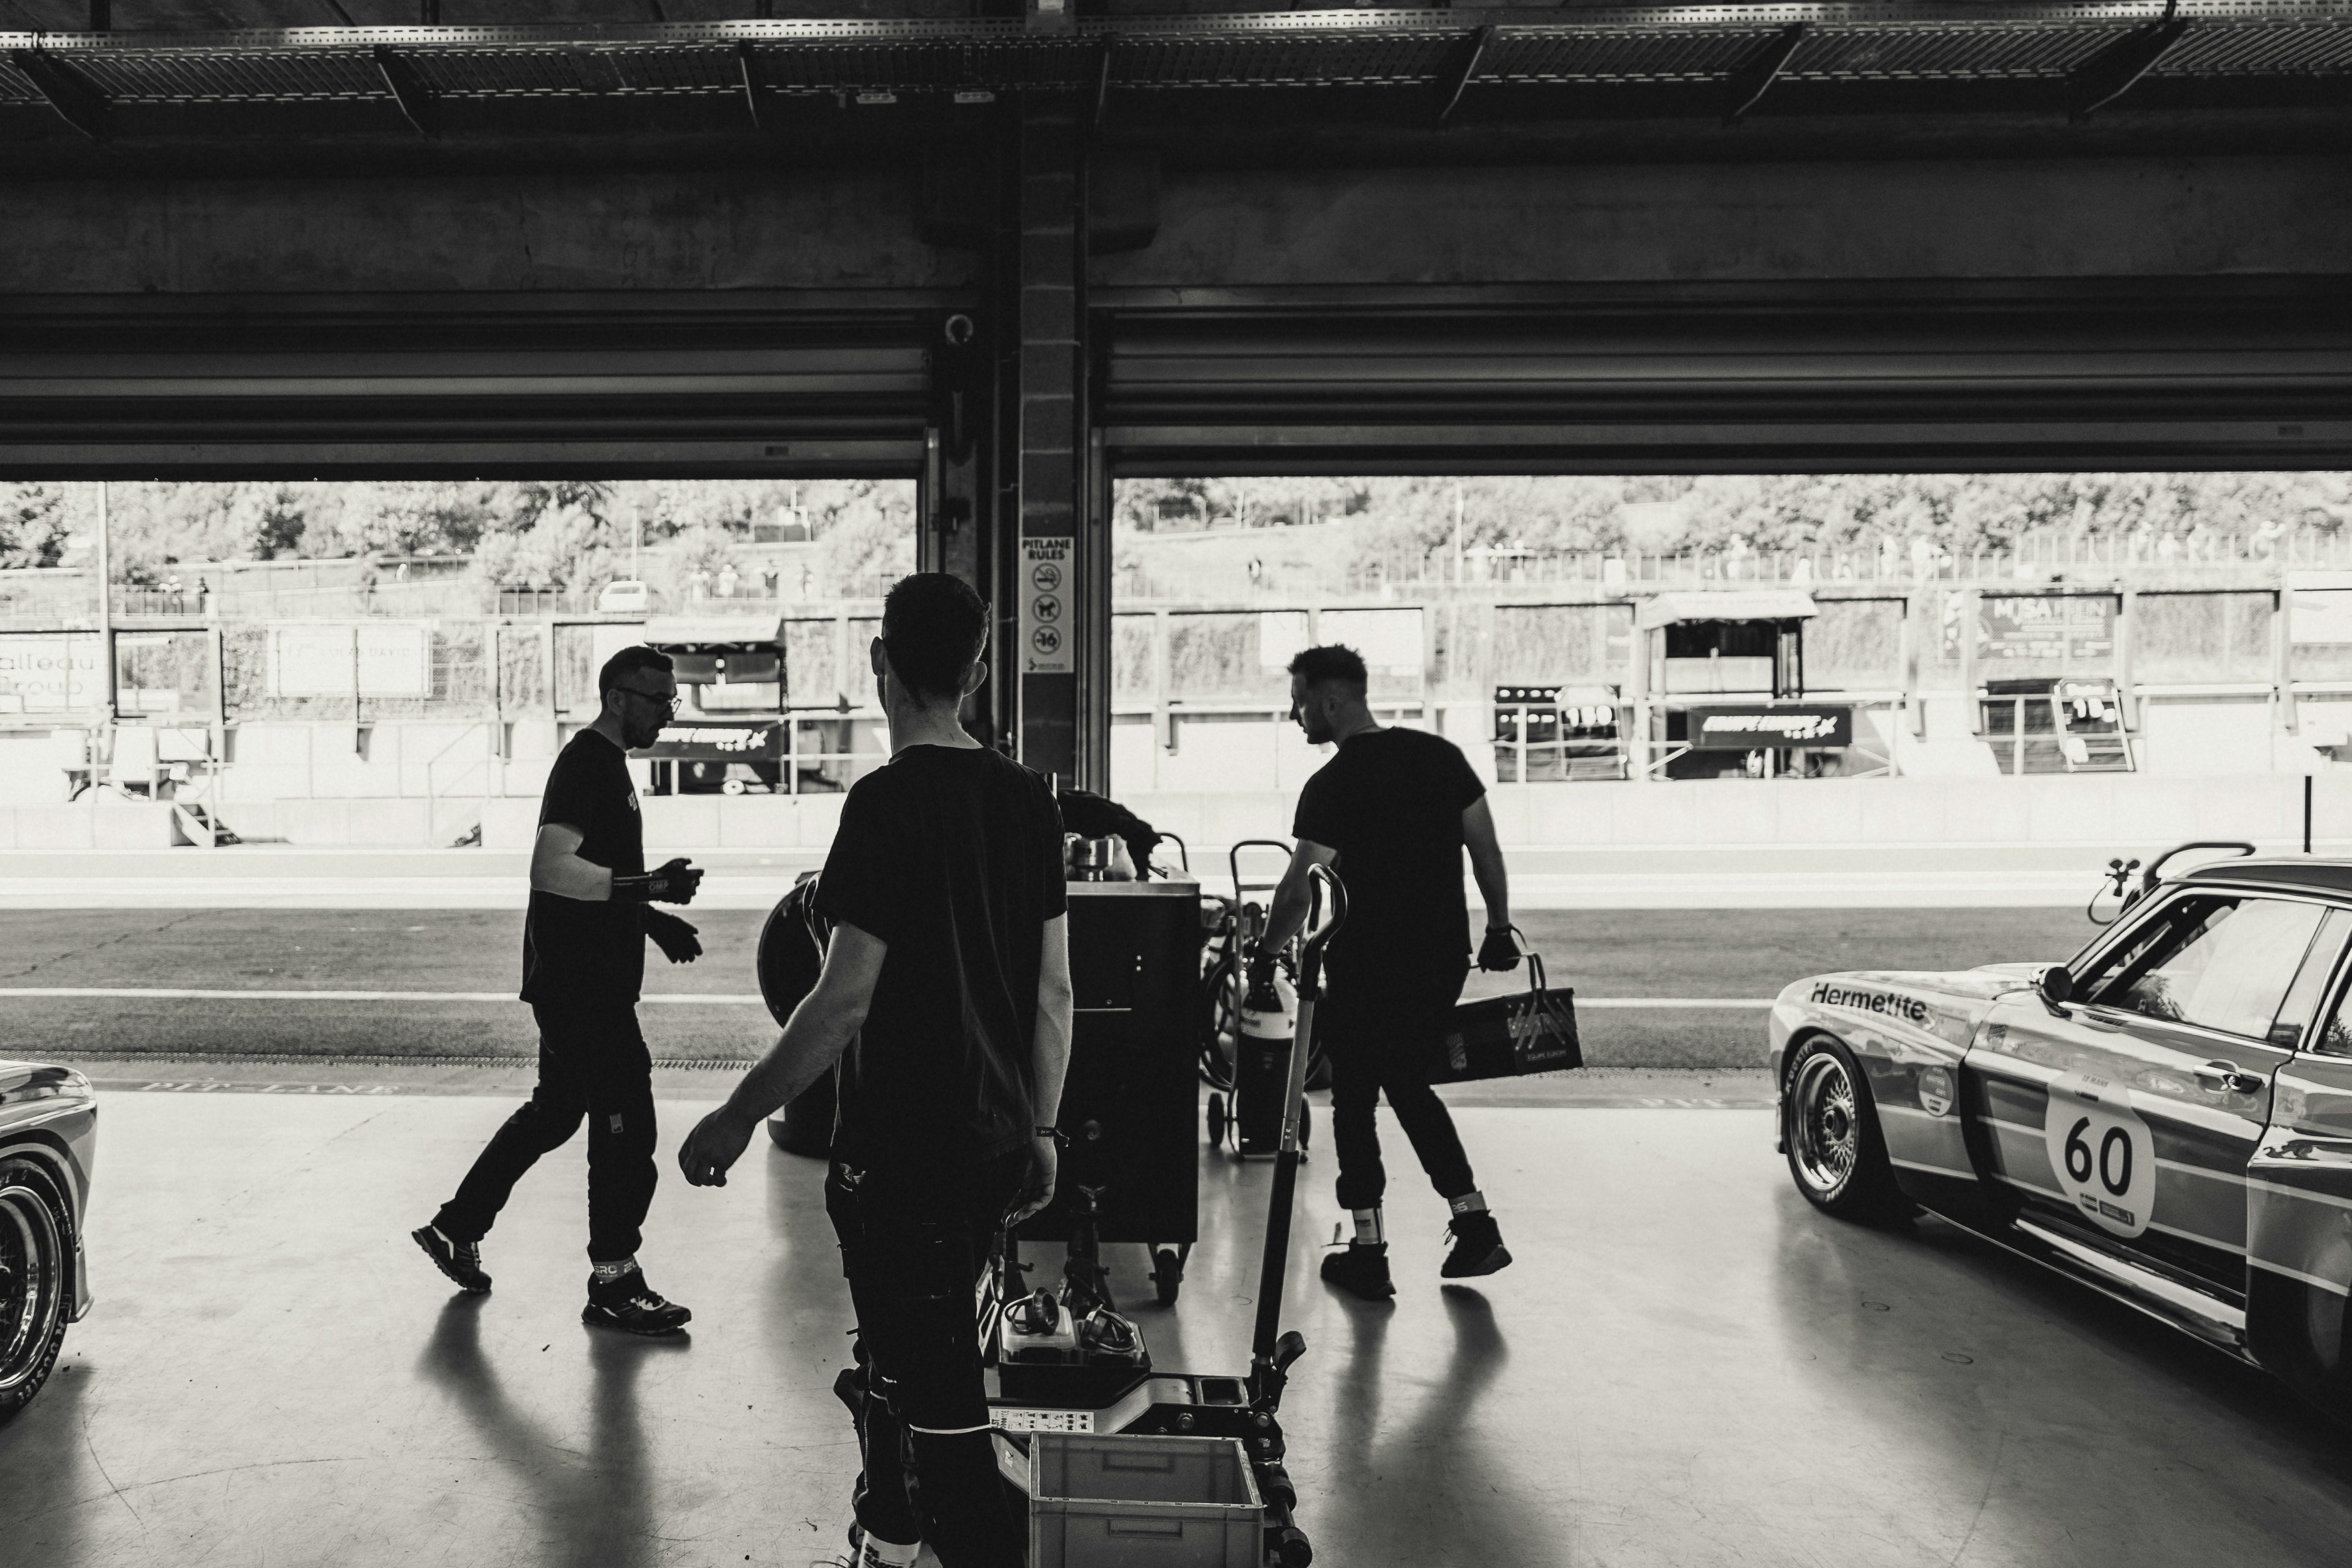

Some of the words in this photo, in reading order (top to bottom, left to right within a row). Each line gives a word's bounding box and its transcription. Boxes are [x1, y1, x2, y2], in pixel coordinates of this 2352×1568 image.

[1022, 539, 1071, 549] PITLANE
[1028, 550, 1065, 560] RULES
[648, 881, 669, 891] OMP
[2065, 1116, 2133, 1197] 60
